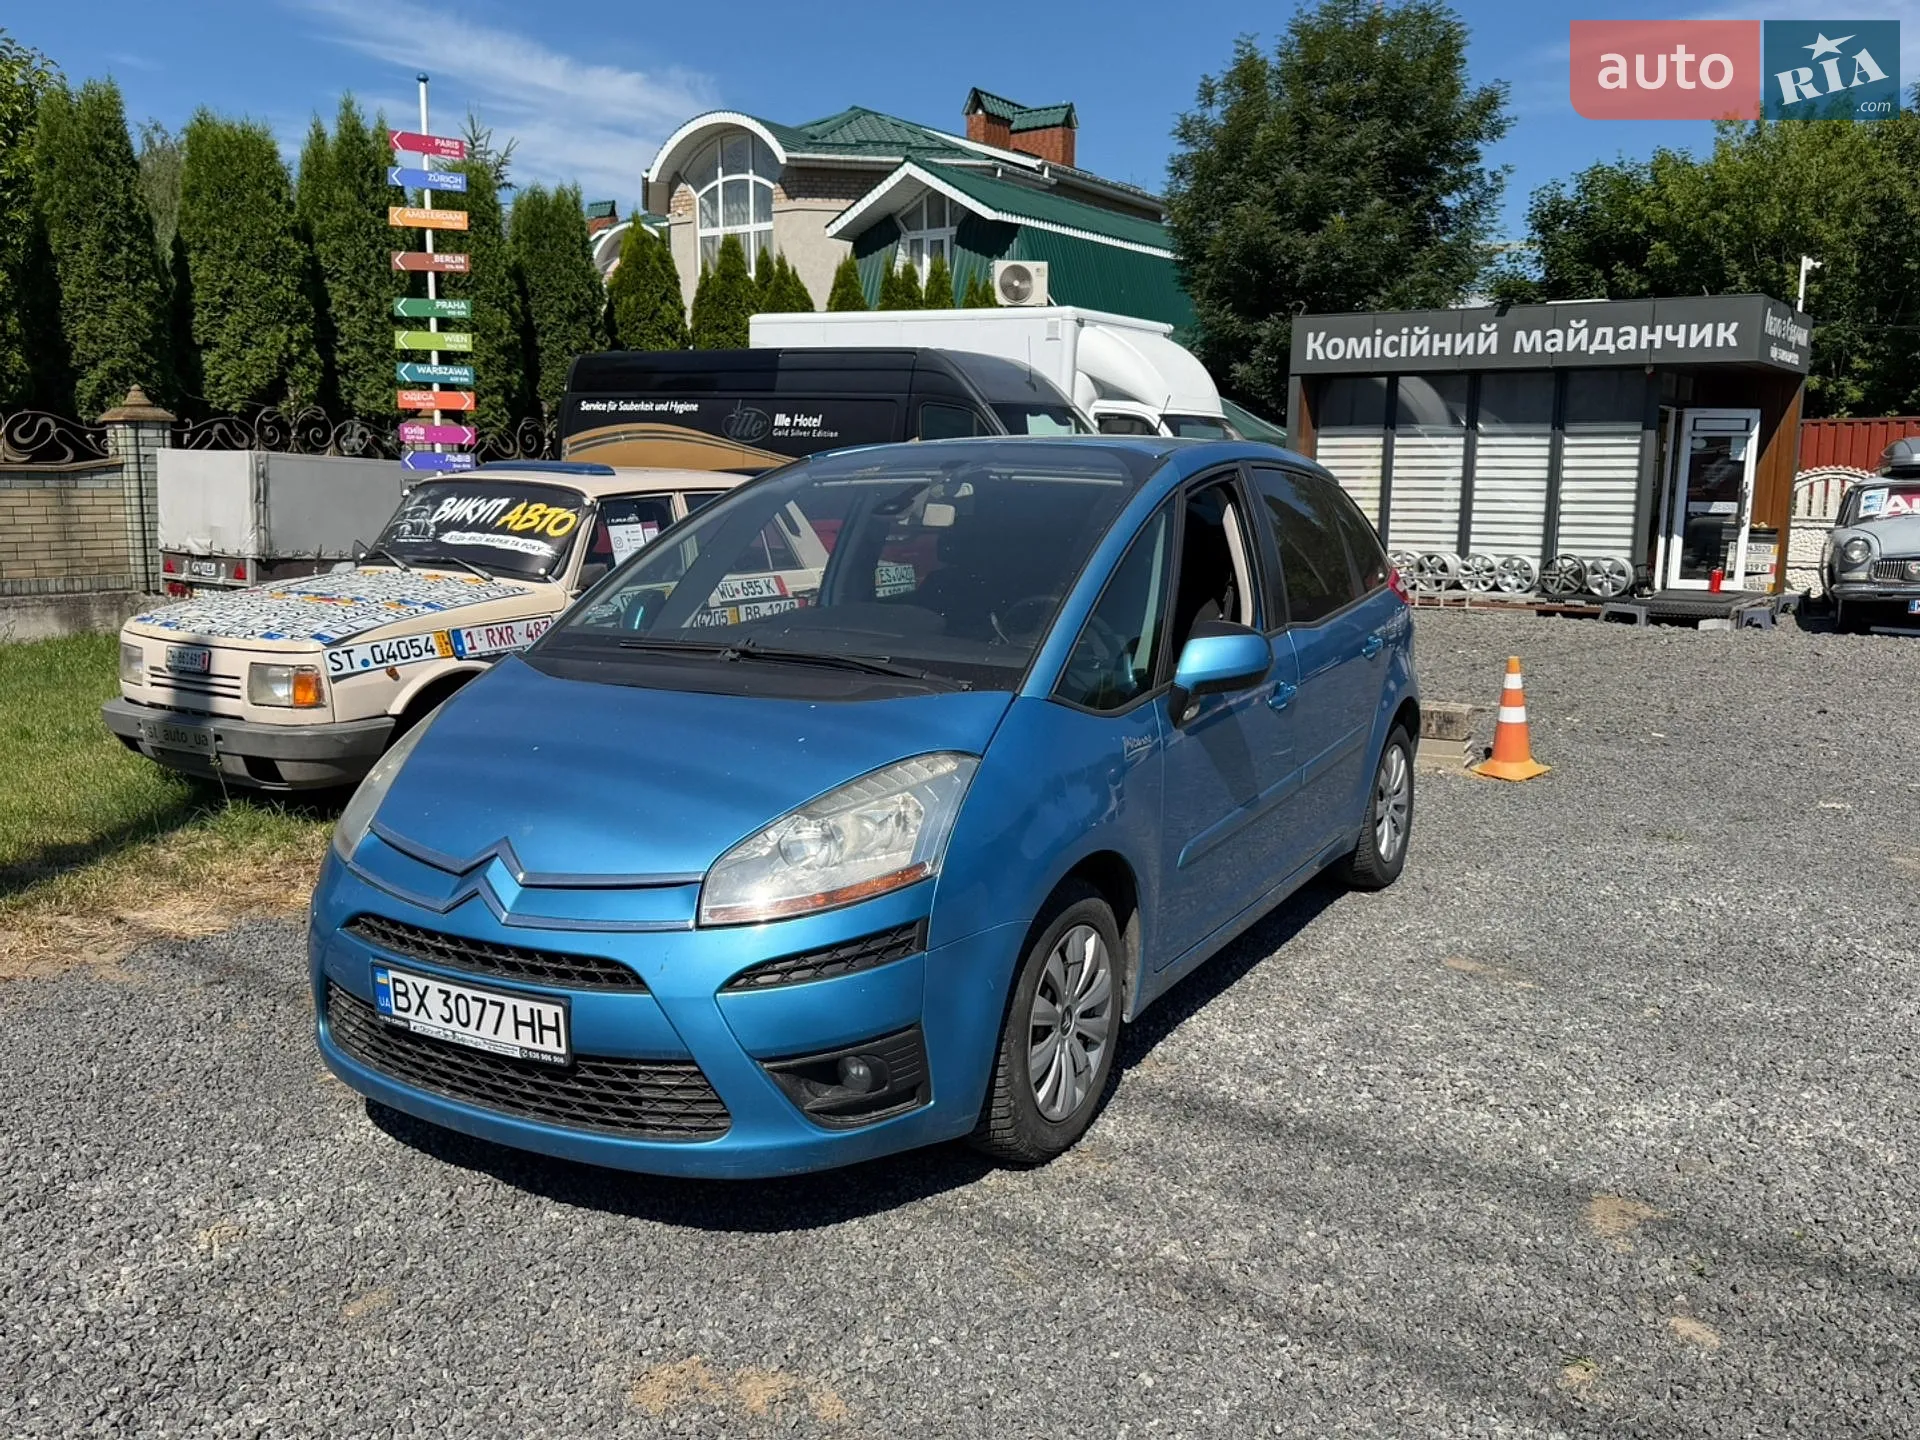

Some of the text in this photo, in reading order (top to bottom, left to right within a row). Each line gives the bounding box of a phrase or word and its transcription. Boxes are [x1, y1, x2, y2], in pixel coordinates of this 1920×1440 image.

[434, 138, 460, 149] PARIS
[428, 173, 462, 184] ZÜRICH
[404, 208, 464, 221] AMSTERDAM
[434, 254, 465, 264] BERLIN
[435, 301, 467, 310] PRAHA
[443, 334, 468, 343] WIEN
[1305, 322, 1499, 361] Комісійний
[1513, 318, 1740, 358] майданчик
[415, 365, 470, 376] WARSZAWA
[402, 392, 435, 402] ОДЕСА
[580, 401, 699, 414] Service für Sauberkeit und Hygiene
[773, 413, 822, 428] Ille Hotel
[403, 425, 425, 435] КИЇВ
[772, 428, 839, 438] Gold Silver Edition
[430, 496, 578, 538] ВИКУП АВТО
[378, 994, 391, 1008] UA
[391, 977, 433, 1020] BX
[436, 988, 506, 1037] 3077
[513, 1004, 562, 1049] HH
